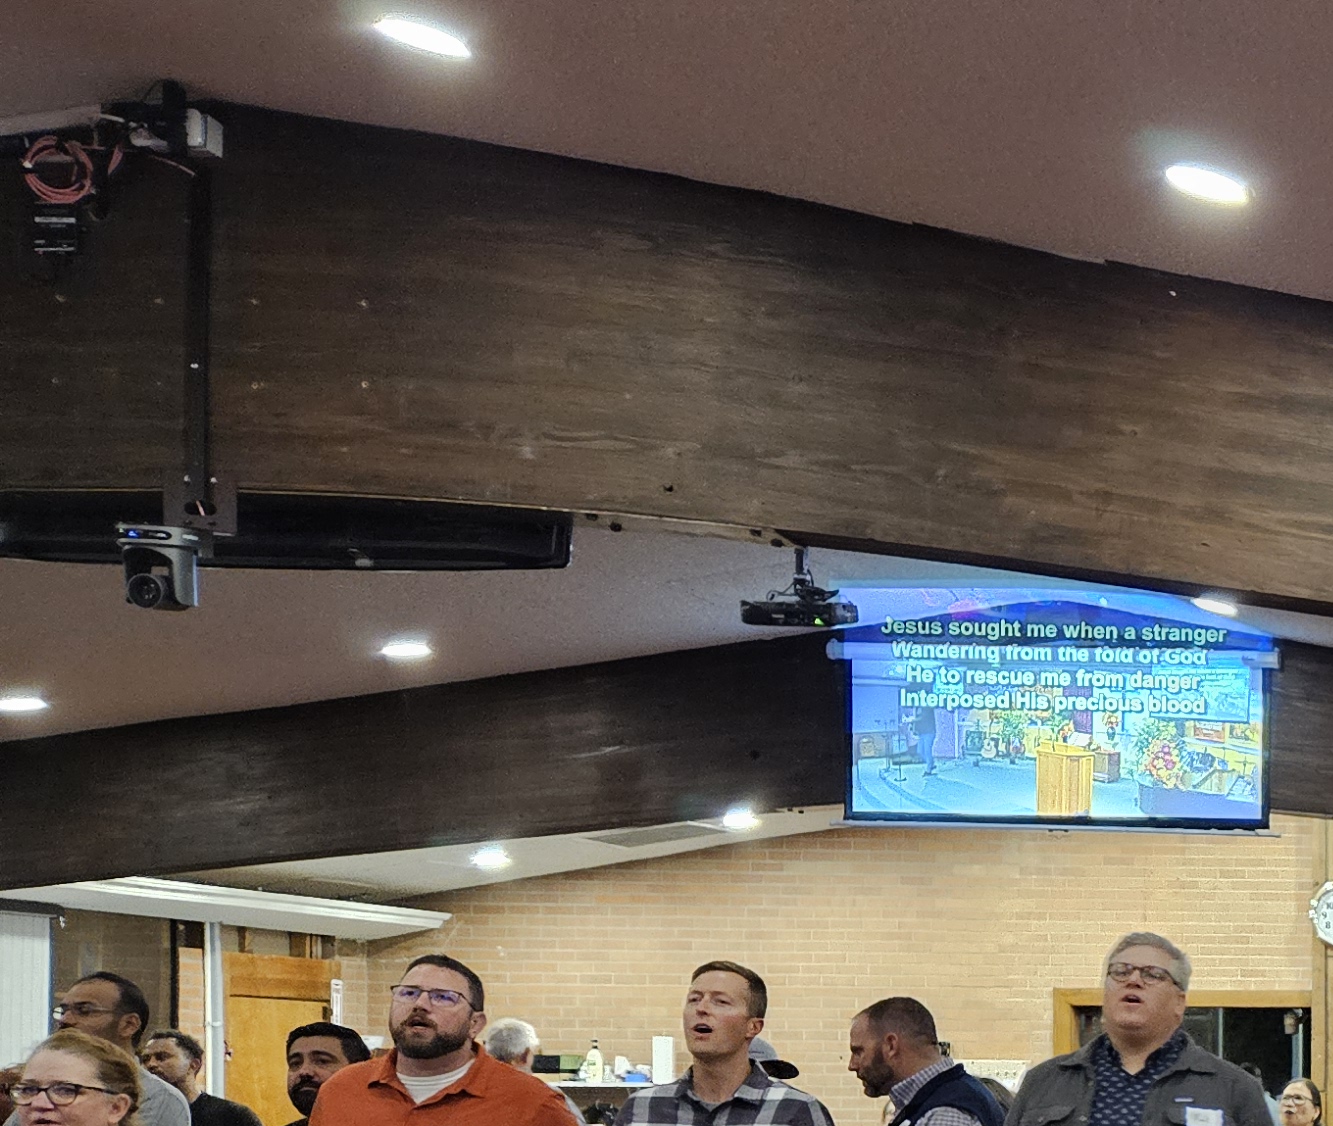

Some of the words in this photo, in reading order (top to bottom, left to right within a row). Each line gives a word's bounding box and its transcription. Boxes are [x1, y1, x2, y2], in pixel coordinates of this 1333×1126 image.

[881, 616, 943, 635] Jesus
[948, 618, 1021, 641] sought
[1027, 623, 1058, 638] me
[1063, 621, 1118, 639] when
[1124, 626, 1136, 640] a
[1141, 624, 1227, 645] stranger
[892, 640, 1000, 663] Wandering
[1006, 643, 1052, 661] from
[1058, 646, 1089, 662] the
[1094, 646, 1133, 664] fold
[1138, 647, 1160, 664] of
[1164, 648, 1207, 665] God
[906, 664, 934, 683] He
[939, 666, 961, 683] to
[966, 669, 1035, 686] rescue
[1040, 671, 1071, 687] me
[1076, 669, 1124, 687] from
[1129, 670, 1200, 692] danger
[900, 688, 1010, 711] Interposed
[1016, 690, 1049, 710] His
[1055, 693, 1142, 714] precious
[1148, 694, 1207, 714] blood
[1325, 921, 1331, 929] 8
